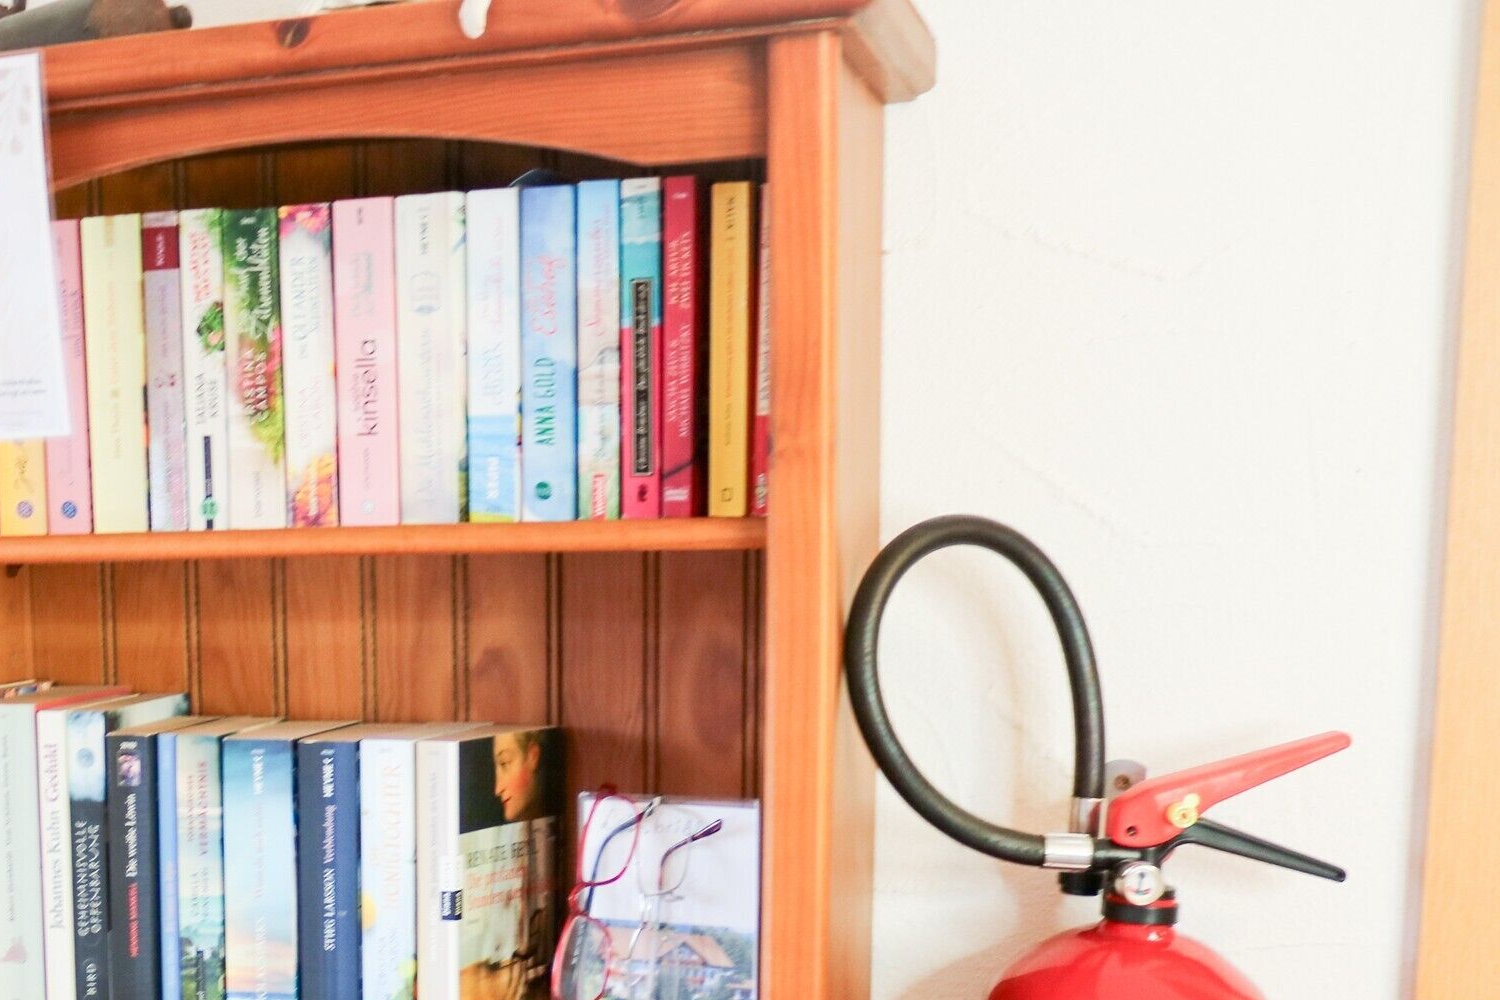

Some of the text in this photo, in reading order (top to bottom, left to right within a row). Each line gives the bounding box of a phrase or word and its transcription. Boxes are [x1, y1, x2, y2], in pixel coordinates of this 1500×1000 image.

[354, 338, 380, 437] kinsella
[533, 357, 557, 399] GOLD
[533, 404, 557, 446] ANNA
